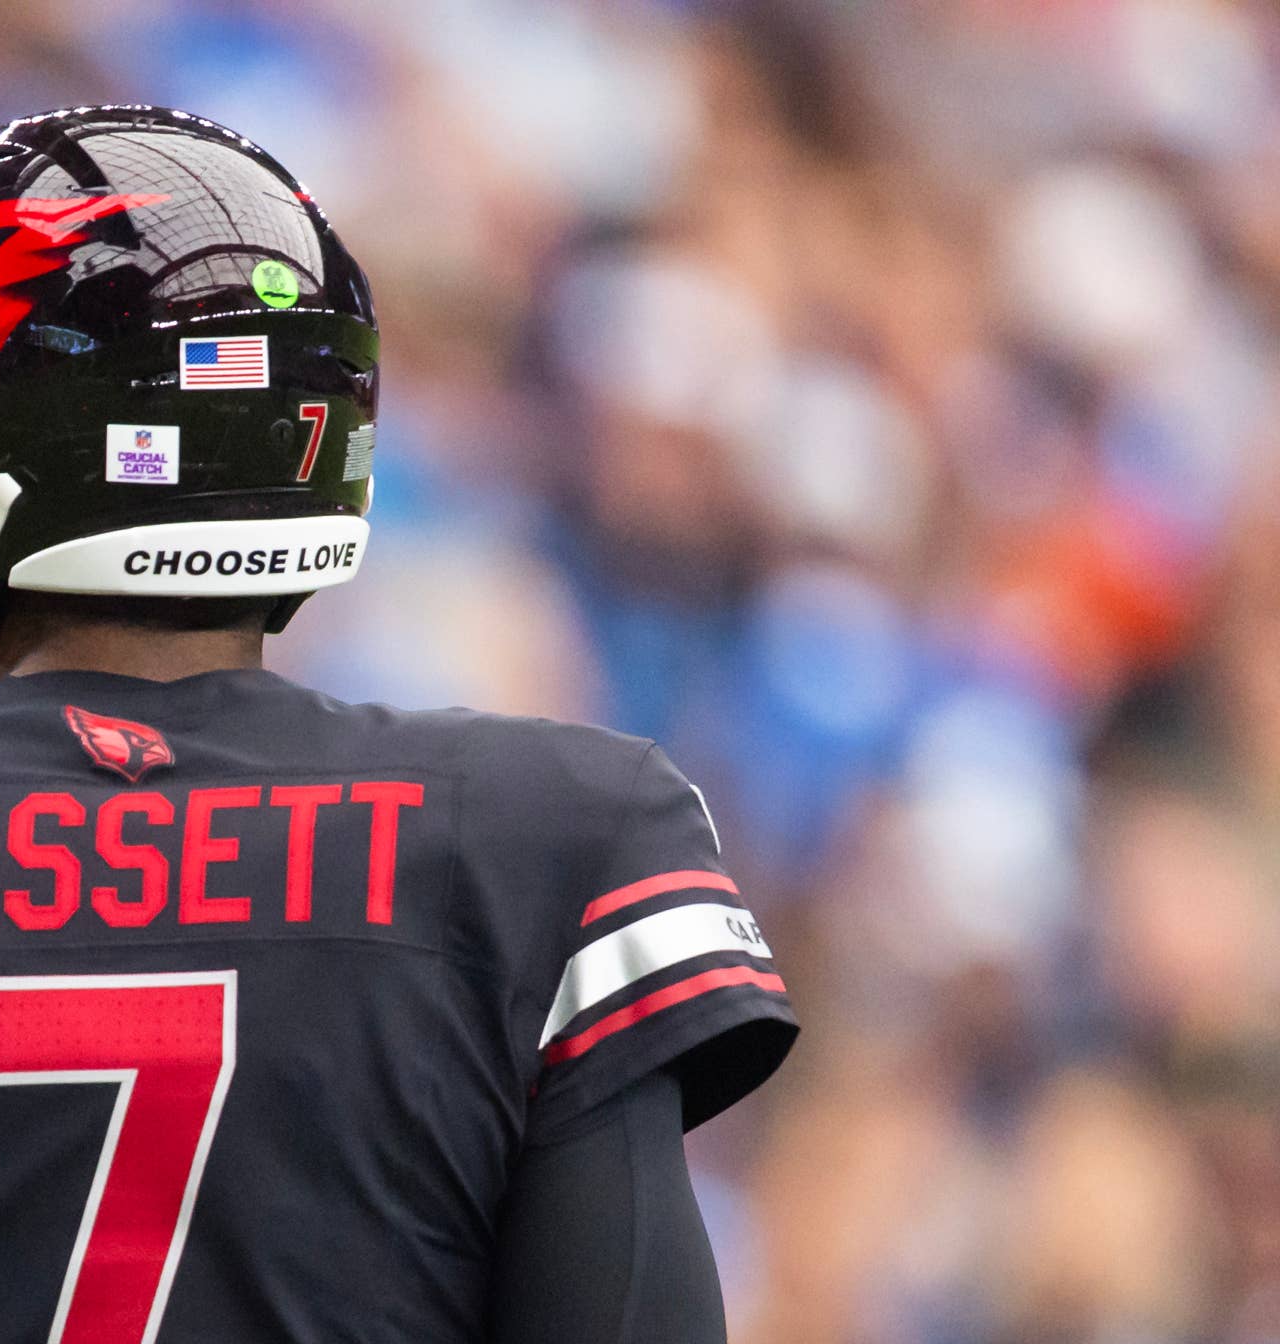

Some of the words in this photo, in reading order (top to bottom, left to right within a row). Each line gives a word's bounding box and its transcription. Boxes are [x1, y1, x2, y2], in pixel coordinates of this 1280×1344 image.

[296, 403, 328, 482] 7
[118, 451, 168, 464] CRUCIAL
[124, 463, 162, 474] CATCH
[123, 549, 288, 576] CHOOSE
[296, 542, 356, 572] LOVE
